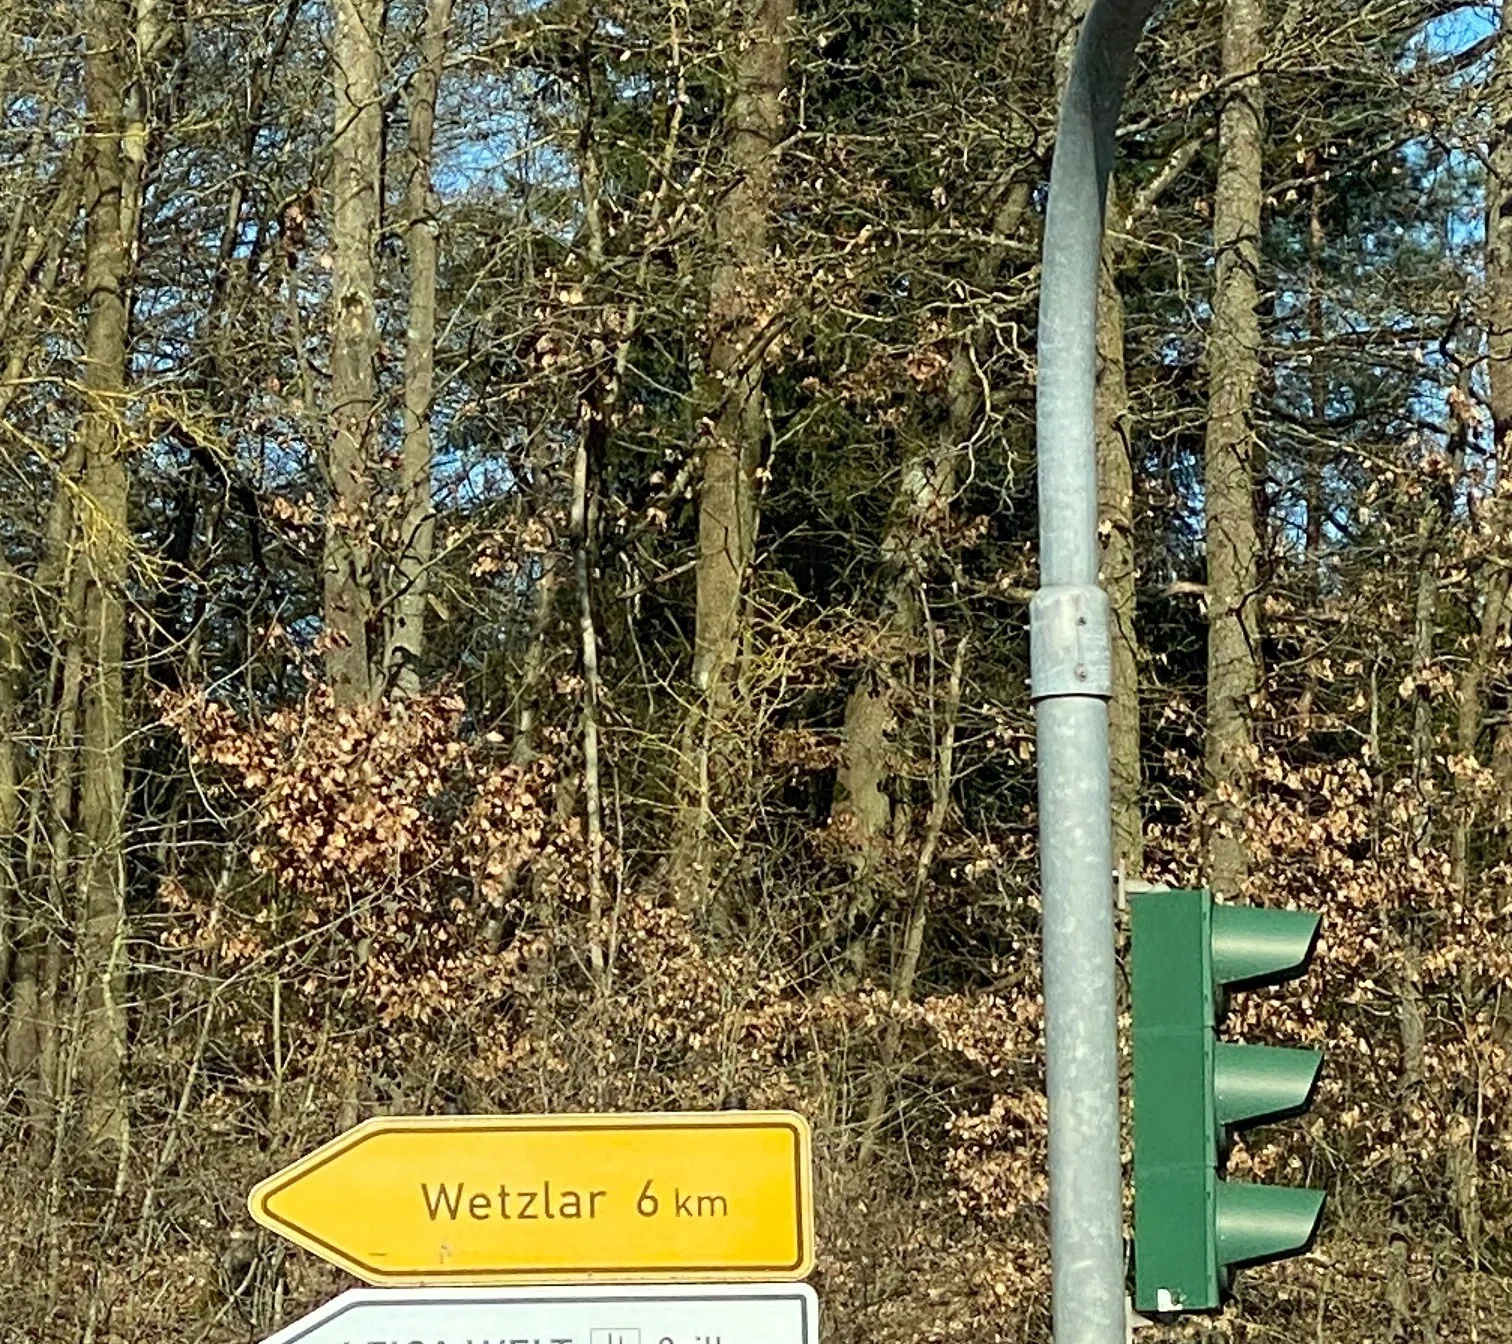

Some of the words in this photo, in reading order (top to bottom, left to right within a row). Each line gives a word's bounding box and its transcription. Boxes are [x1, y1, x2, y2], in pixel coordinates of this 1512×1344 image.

[421, 1182, 607, 1221] Wetzlar
[637, 1180, 659, 1218] 6
[675, 1188, 727, 1218] km
